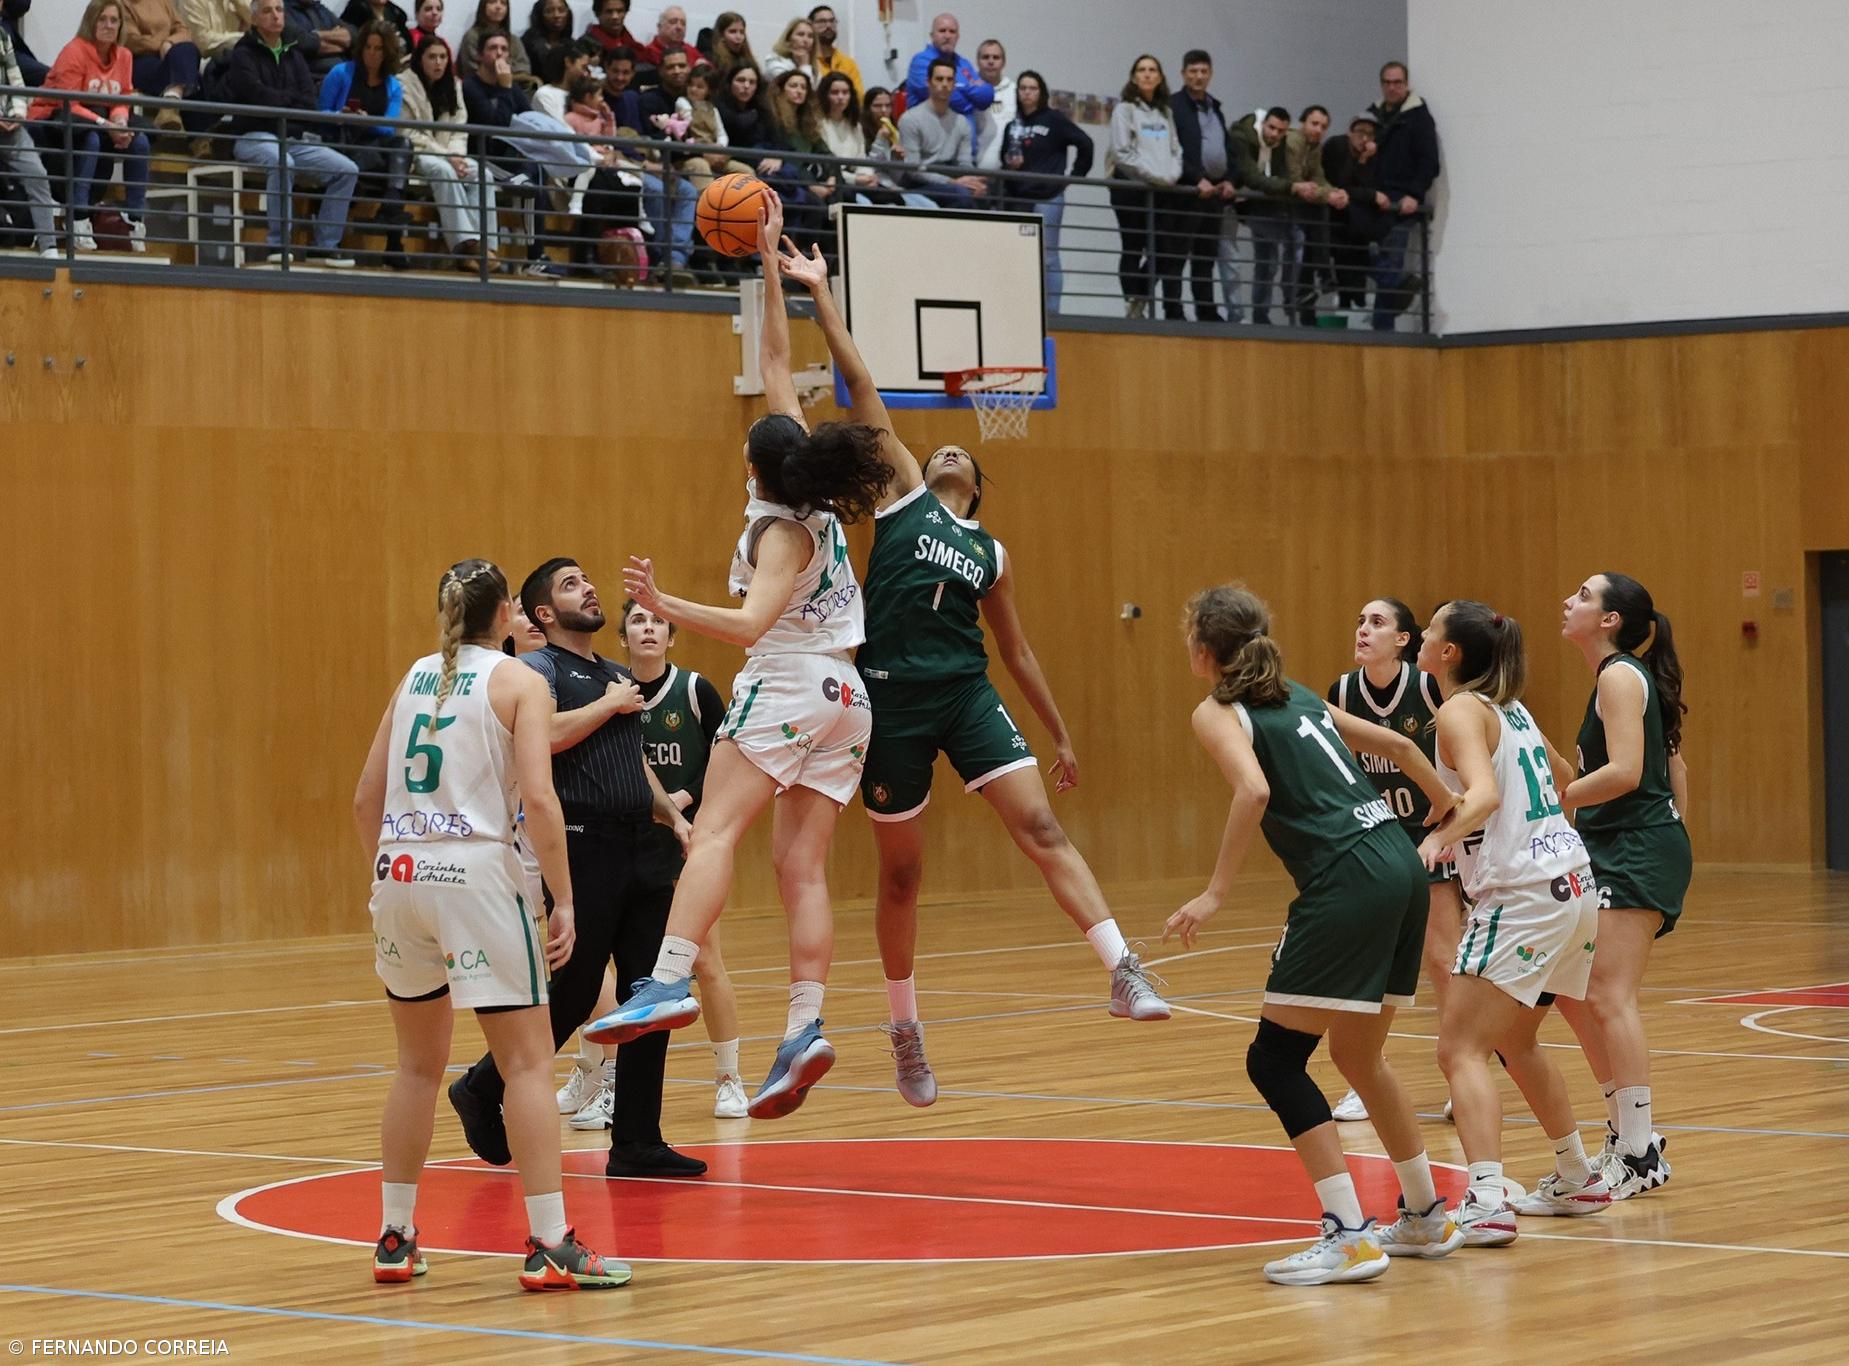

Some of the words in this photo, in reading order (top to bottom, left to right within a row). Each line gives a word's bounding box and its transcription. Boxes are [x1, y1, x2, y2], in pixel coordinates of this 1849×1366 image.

[914, 534, 984, 590] SIMECQ
[996, 703, 1018, 732] 1
[404, 713, 457, 794] 5
[648, 742, 683, 766] ECQ
[1380, 787, 1415, 818] 10
[382, 811, 474, 841] AÇORES
[565, 825, 585, 834] LDING
[416, 860, 467, 874] Cozinha
[380, 936, 401, 960] CA
[460, 949, 491, 970] CA
